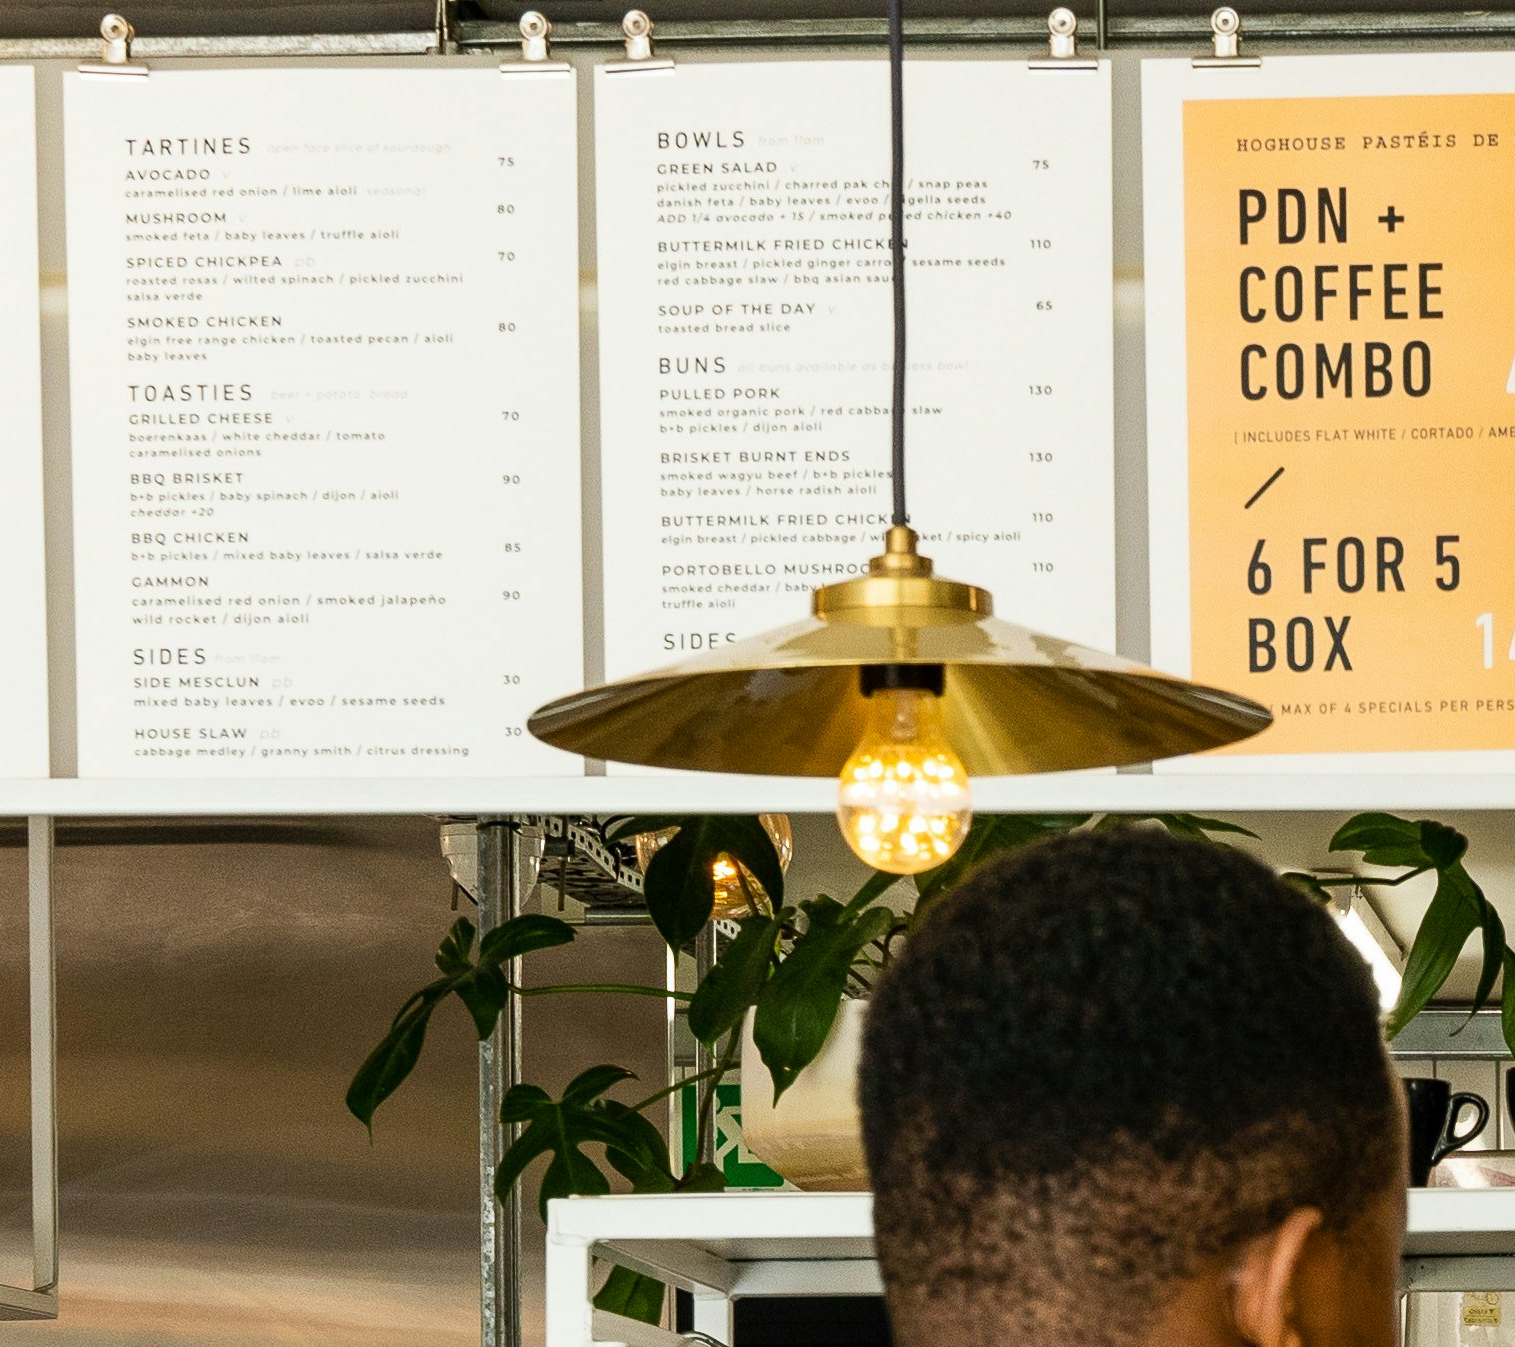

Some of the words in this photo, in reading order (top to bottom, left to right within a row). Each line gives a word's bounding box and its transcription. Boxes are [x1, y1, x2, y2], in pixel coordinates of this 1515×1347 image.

[126, 137, 250, 155] TARTINES
[658, 131, 744, 149] BOWLS
[1237, 137, 1345, 152] HOGHOUSE
[1363, 131, 1456, 149] PASTÉIS
[1473, 133, 1498, 147] DE
[498, 157, 514, 167] 75
[657, 163, 713, 175] GREEN
[721, 162, 777, 173] SALAD
[1033, 160, 1049, 169] 75
[126, 169, 210, 181] AVOCADO
[1239, 187, 1347, 245] PDN
[126, 257, 187, 268] SPICED
[195, 256, 282, 267] CHICKPEA
[127, 293, 159, 301] salsa
[165, 292, 202, 300] verde
[1240, 263, 1443, 323] COFFEE
[658, 305, 704, 316] SOUP
[712, 304, 732, 315] OF
[741, 304, 772, 315] THE
[781, 303, 814, 314] DAY
[128, 317, 199, 328] SMOKED
[206, 316, 281, 327] CHICKEN
[658, 324, 709, 333] toasted
[715, 323, 754, 332] bread
[760, 323, 790, 332] slice
[659, 356, 725, 374] BUNS
[1241, 340, 1431, 401] COMBO
[128, 384, 252, 402] TOASTIES
[660, 388, 725, 400] PULLED
[733, 388, 779, 399] PORK
[129, 413, 200, 425] GRILLED
[207, 413, 272, 424] CHEESE
[129, 449, 211, 458] caramelised
[216, 449, 261, 457] onions
[1248, 539, 1272, 595] 6
[1303, 536, 1405, 594] FOR
[1436, 535, 1460, 592] 5
[1249, 616, 1352, 673] BOX
[134, 648, 206, 665] SIDES
[1281, 704, 1311, 715] MAX
[1319, 702, 1336, 714] OF
[1359, 701, 1432, 714] SPECIALS
[1440, 700, 1468, 712] PER
[135, 728, 190, 739] HOUSE
[199, 728, 246, 739] SLAW
